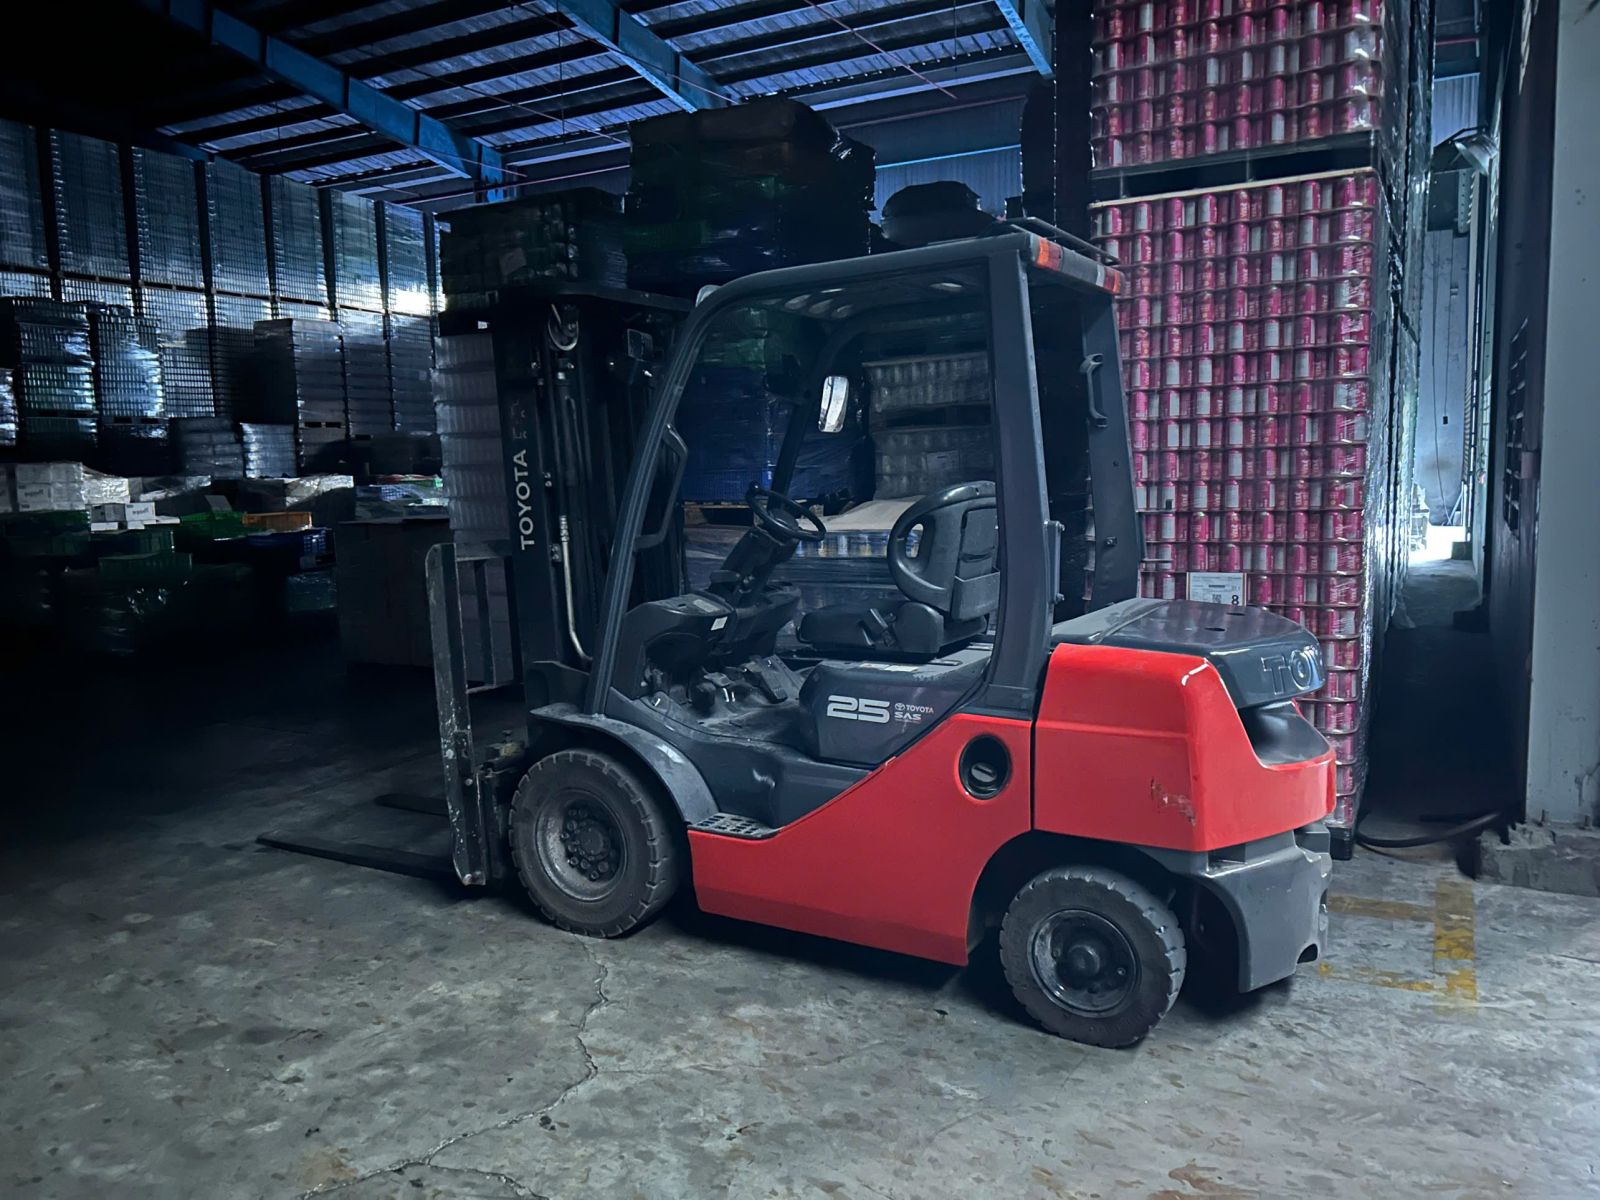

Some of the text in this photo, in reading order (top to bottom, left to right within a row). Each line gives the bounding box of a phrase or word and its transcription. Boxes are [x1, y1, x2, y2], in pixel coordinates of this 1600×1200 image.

[513, 449, 535, 550] TOYOTA
[1231, 594, 1239, 606] 8
[827, 695, 890, 723] 25
[906, 704, 935, 714] TOYOTA
[894, 711, 922, 721] SAS
